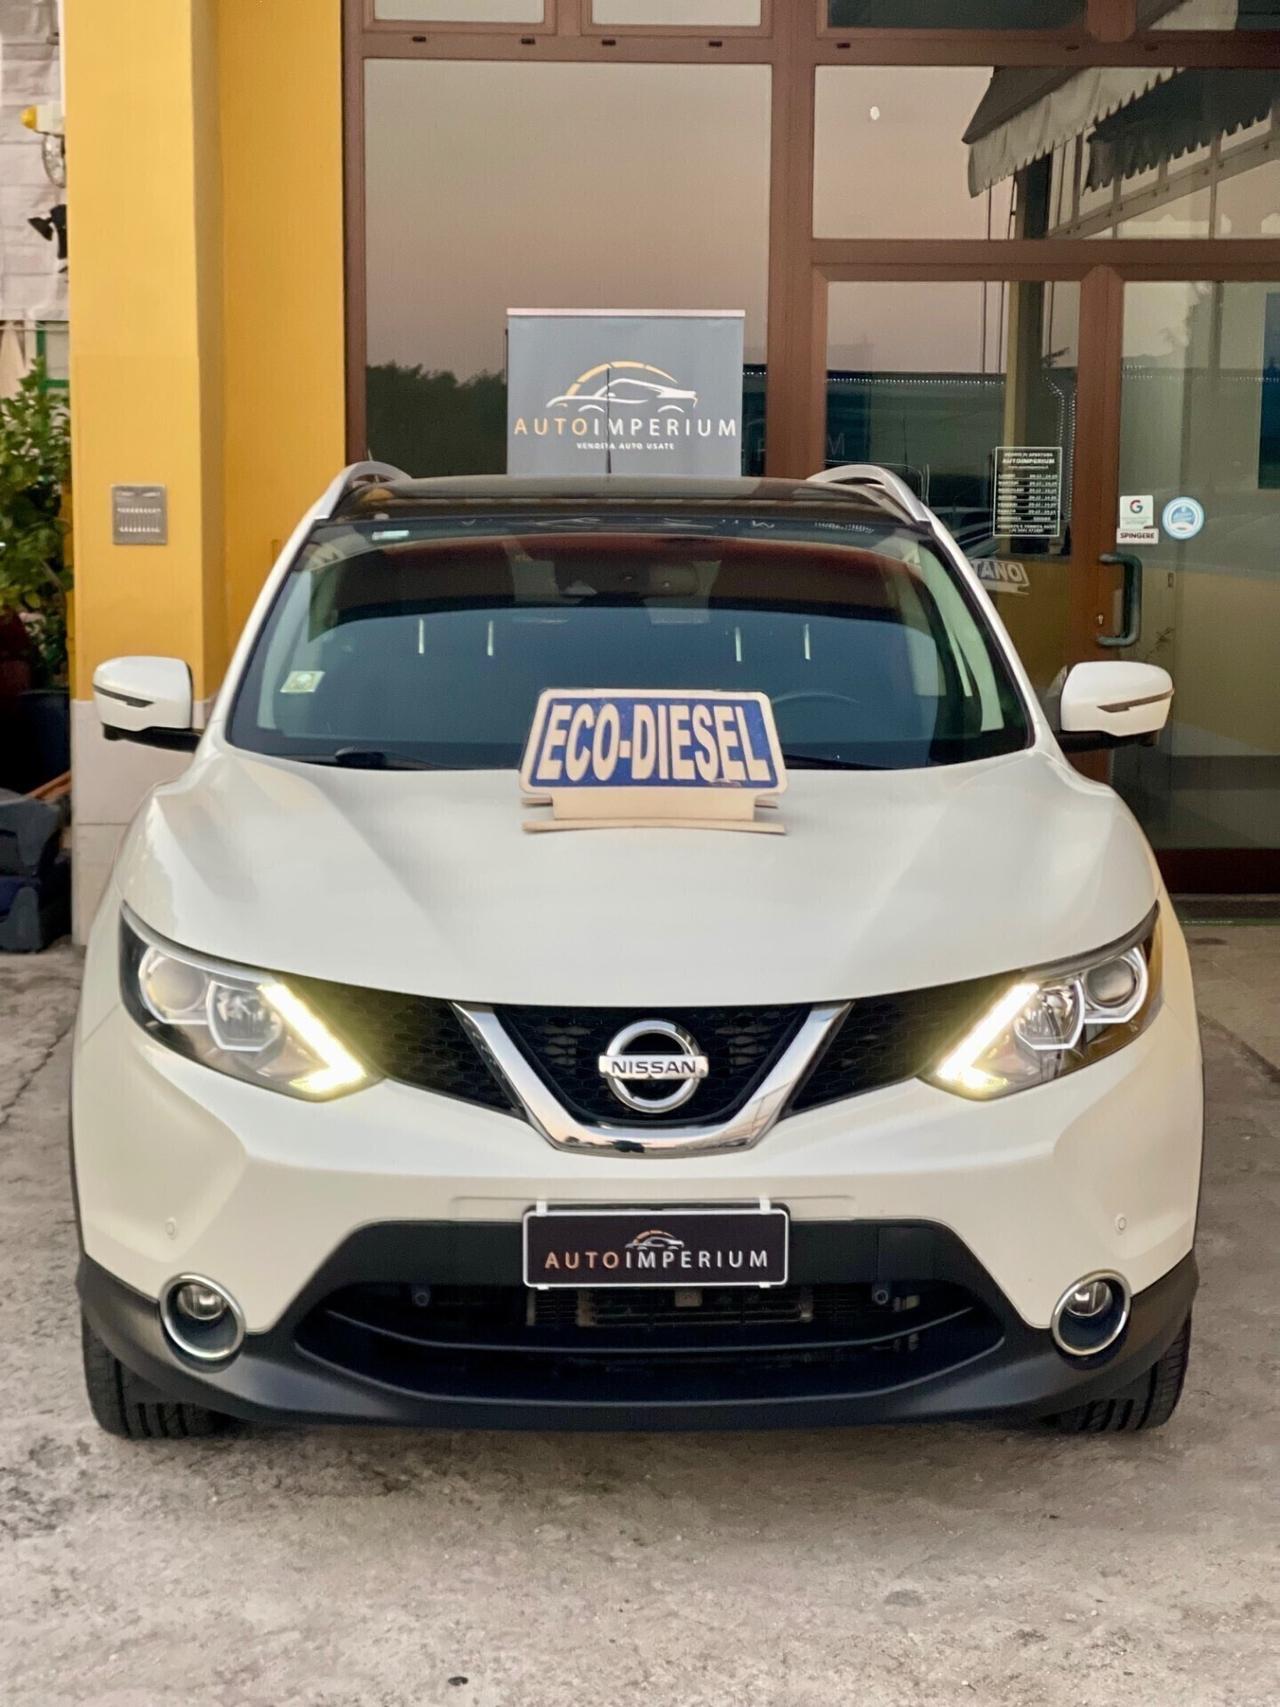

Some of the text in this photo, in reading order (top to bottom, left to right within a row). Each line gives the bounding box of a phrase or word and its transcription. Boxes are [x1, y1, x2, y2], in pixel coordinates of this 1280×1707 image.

[513, 417, 737, 436] AUTOIMPERIUM
[618, 442, 643, 450] AUTO
[646, 442, 675, 450] USATE
[1129, 499, 1143, 514] G
[536, 703, 771, 782] ECO-DIESEL
[611, 1061, 697, 1074] NISSAN
[544, 1250, 769, 1269] AUTOIMPERIUM
